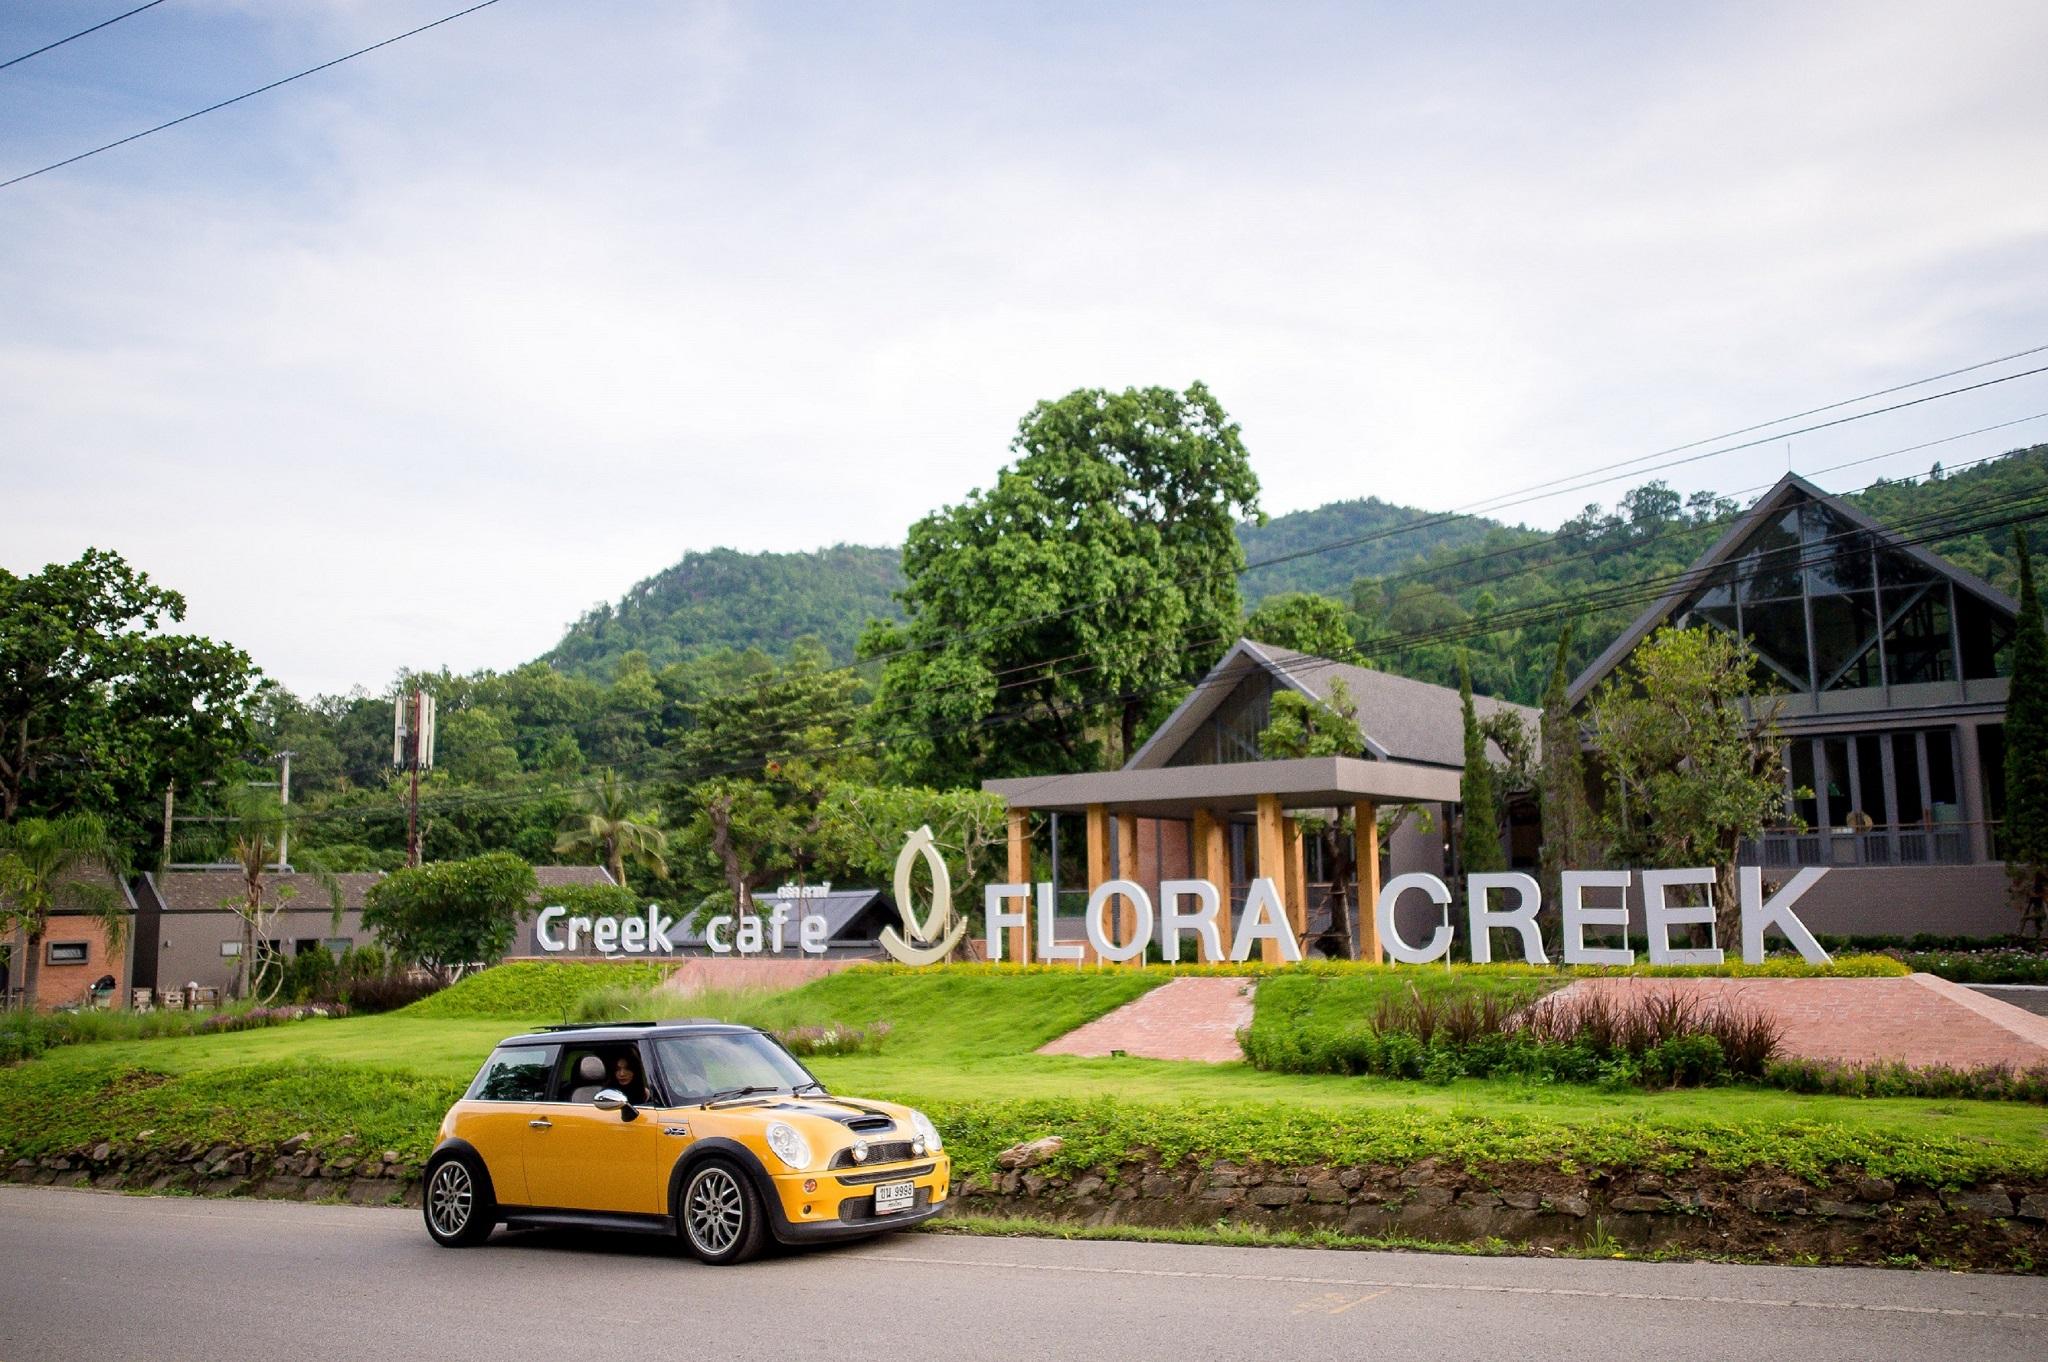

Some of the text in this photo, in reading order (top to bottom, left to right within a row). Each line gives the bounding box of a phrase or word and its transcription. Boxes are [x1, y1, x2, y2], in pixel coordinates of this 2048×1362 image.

[536, 902, 828, 953] Creek cafe
[985, 866, 1833, 965] FLORA CREEK
